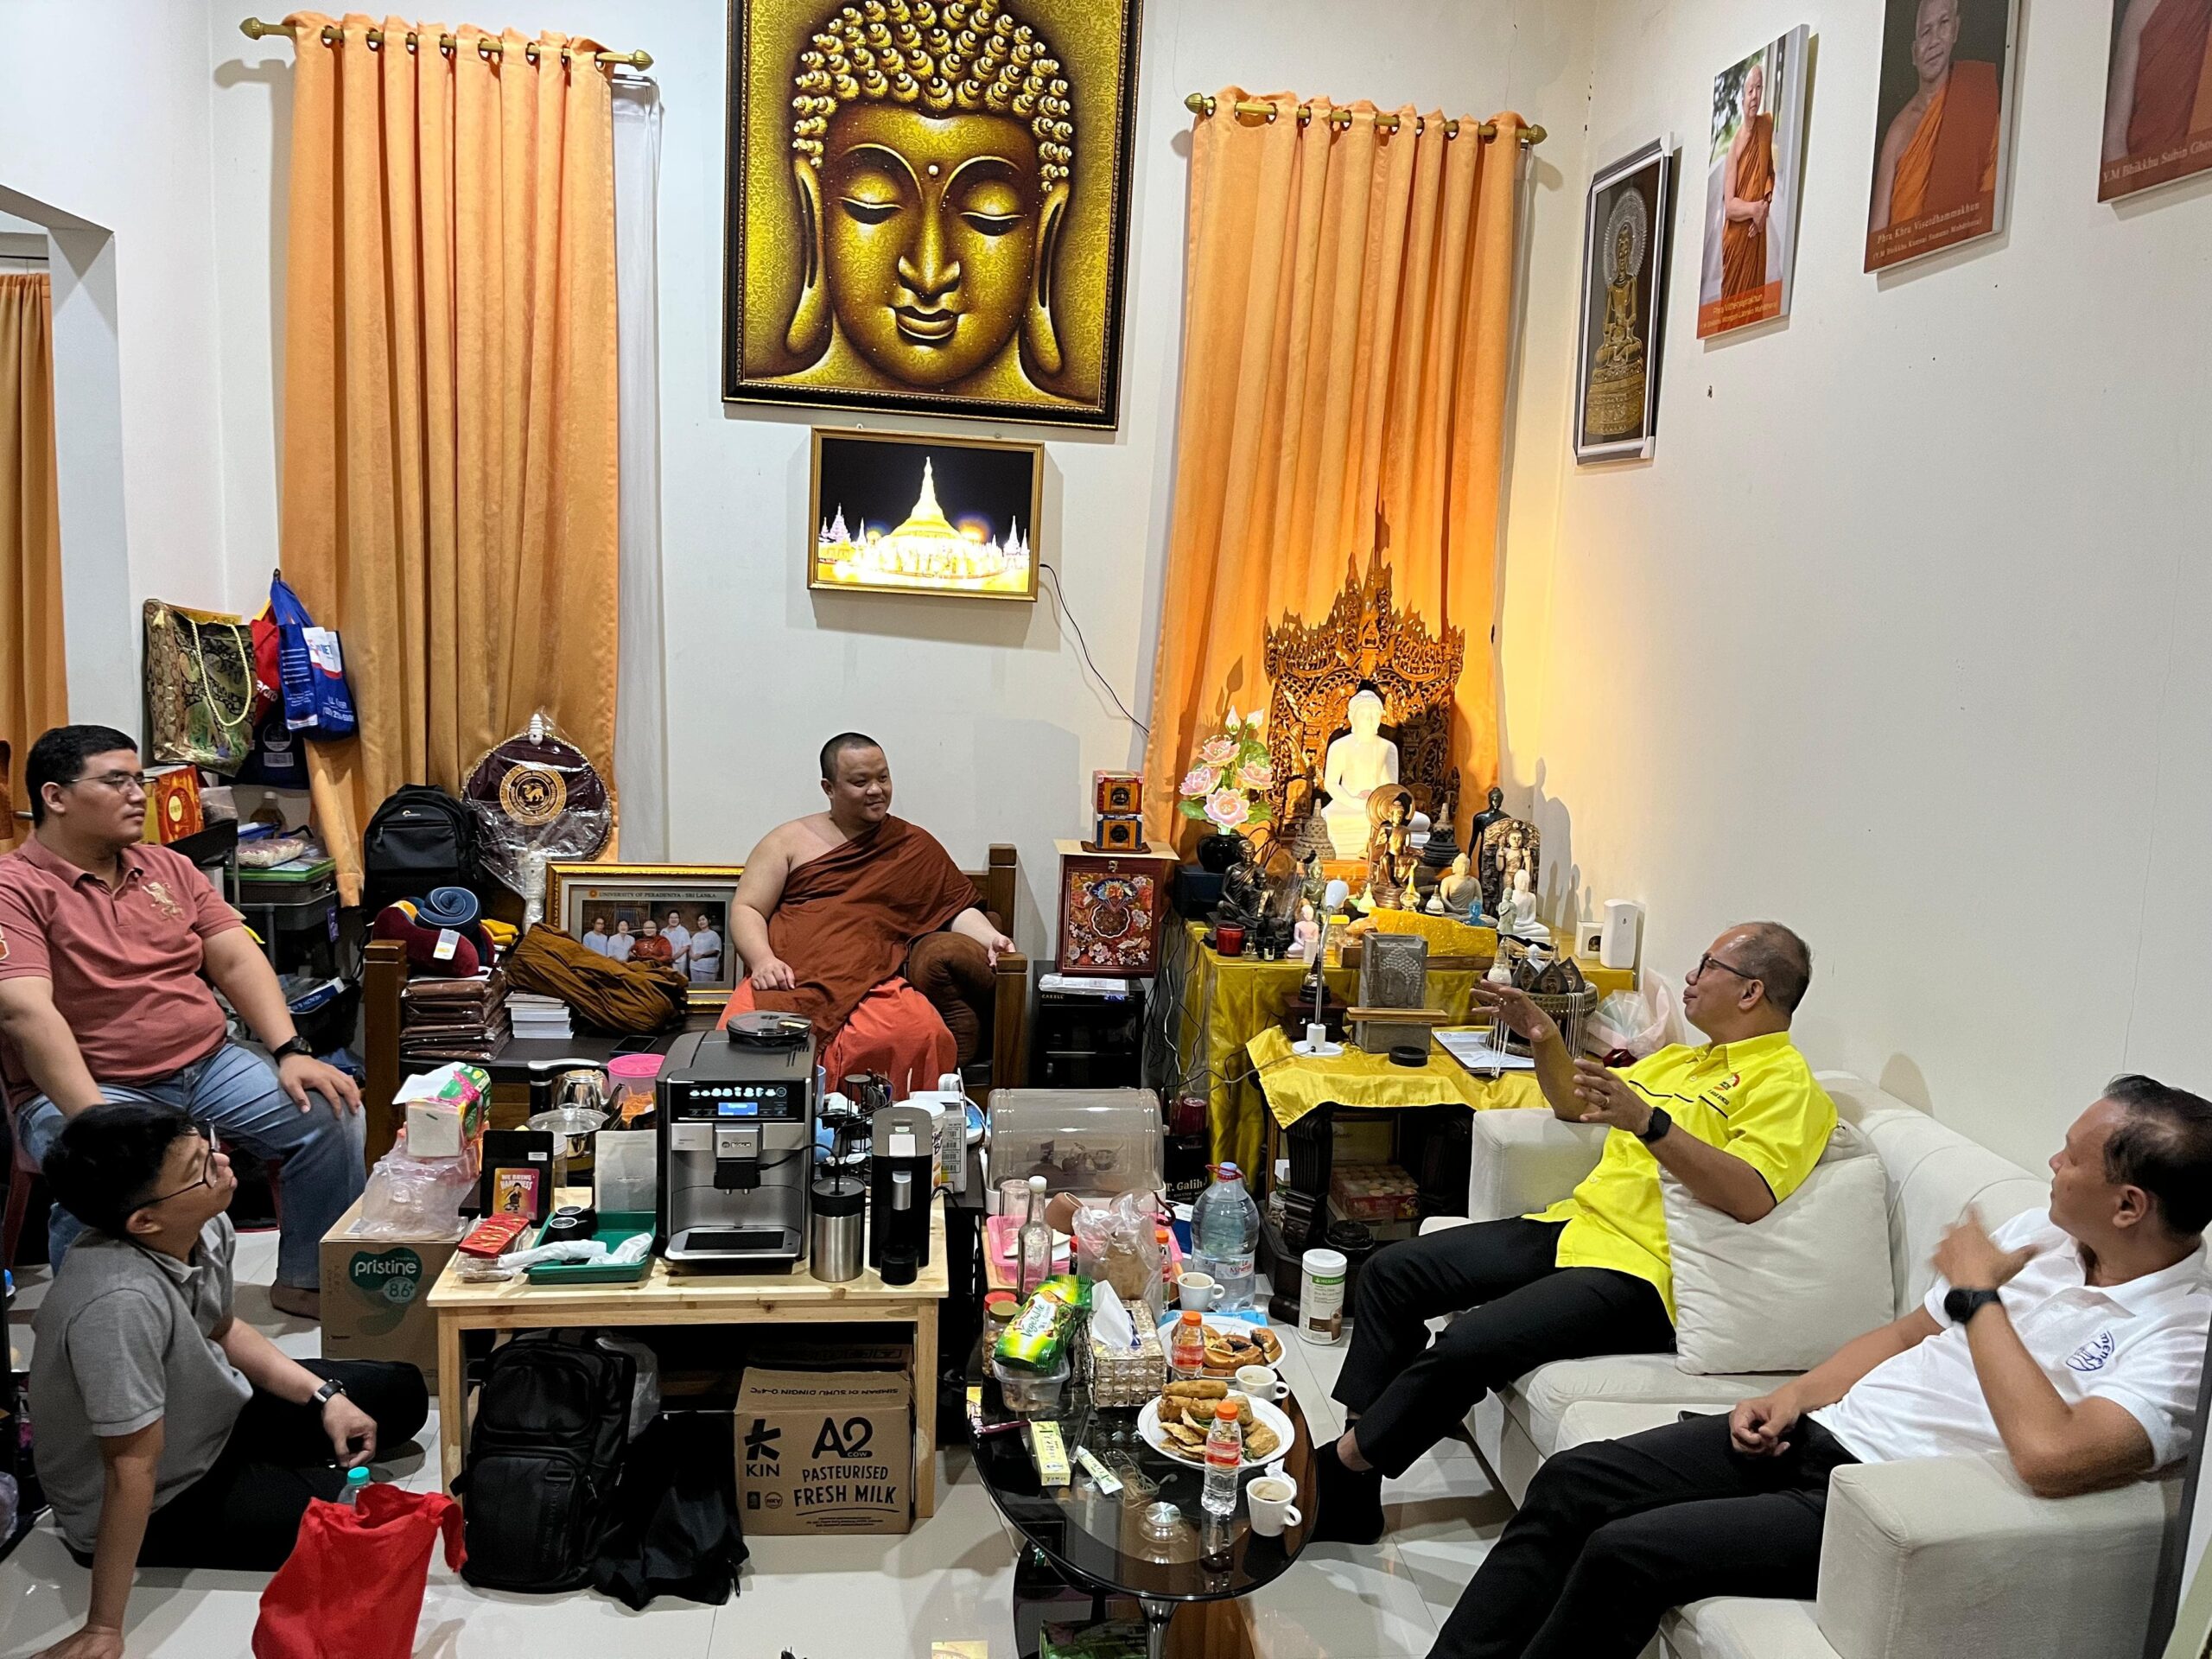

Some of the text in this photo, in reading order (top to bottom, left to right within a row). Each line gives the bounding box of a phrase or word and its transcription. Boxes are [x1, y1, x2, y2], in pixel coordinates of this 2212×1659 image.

[1176, 1179, 1203, 1191] Galih
[355, 1260, 416, 1276] pristine
[811, 1416, 874, 1459] A2
[746, 1464, 780, 1478] KIN
[802, 1465, 888, 1483] PASTEURISED
[793, 1484, 897, 1507] FRESH MILK
